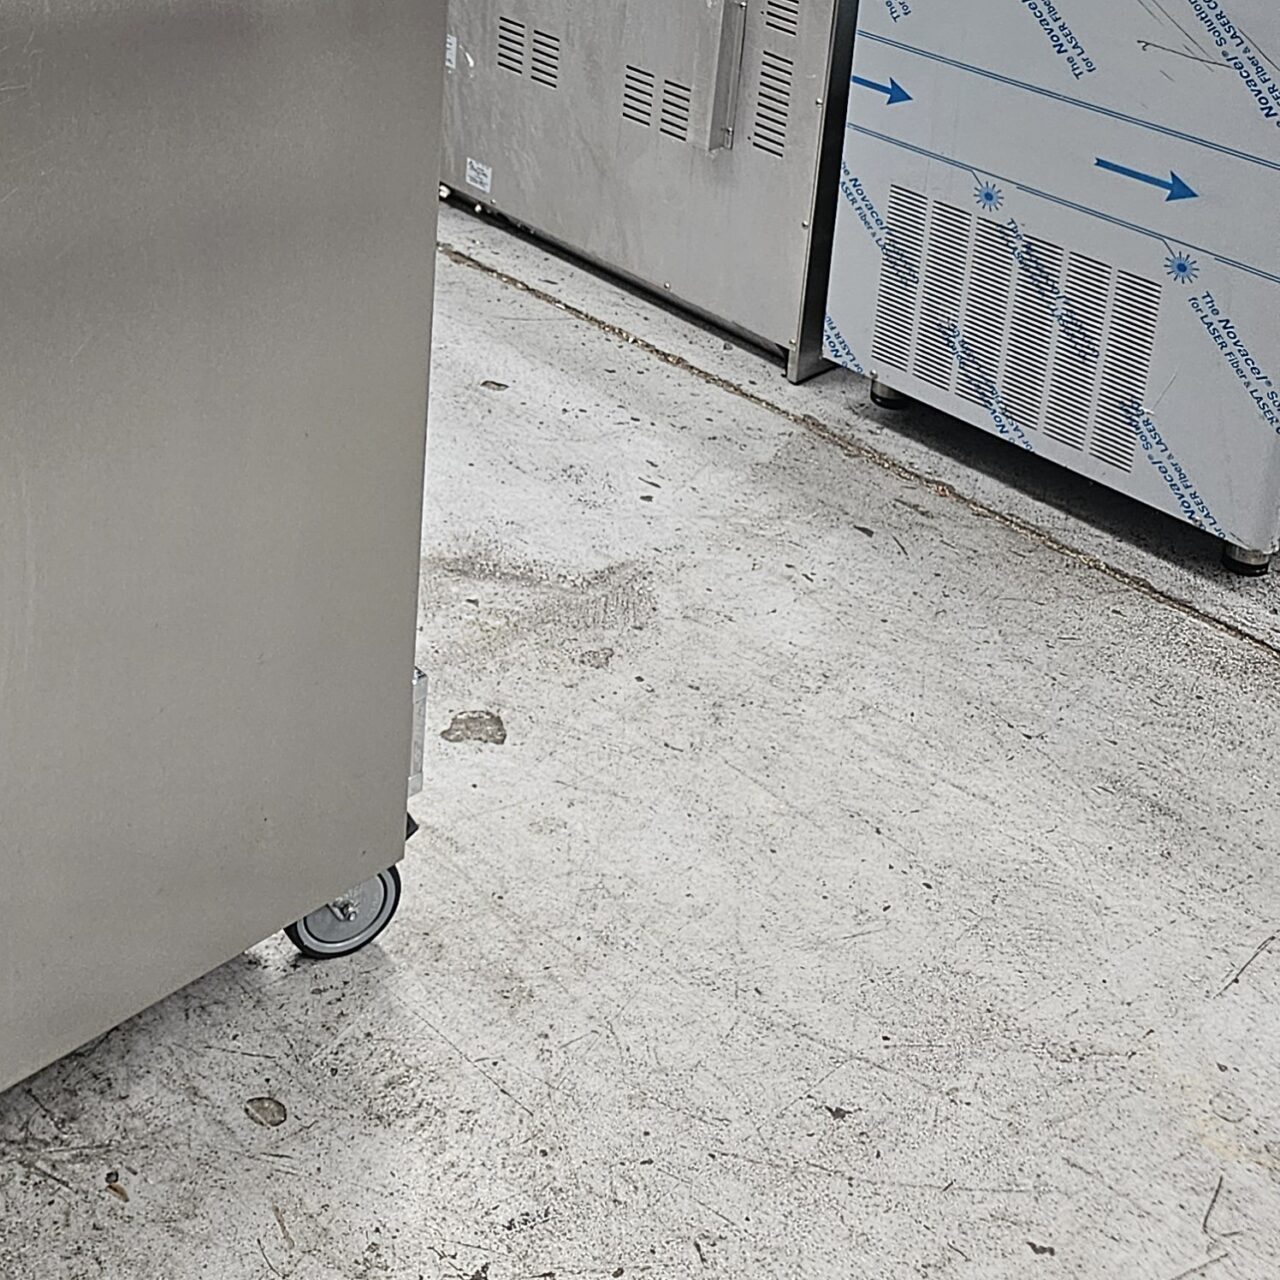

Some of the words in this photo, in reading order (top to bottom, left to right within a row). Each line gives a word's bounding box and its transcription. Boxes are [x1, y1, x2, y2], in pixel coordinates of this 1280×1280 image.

[885, 0, 900, 22] The
[898, 1, 911, 15] for
[1058, 21, 1084, 56] LASER
[1214, 10, 1244, 47] LASER
[1066, 56, 1083, 80] The
[1081, 57, 1096, 72] for
[1246, 55, 1271, 84] Fiber
[837, 180, 857, 205] ASER
[1201, 290, 1219, 315] The
[1187, 296, 1203, 313] for
[1199, 314, 1227, 350] LASER
[1223, 351, 1247, 379] Fiber
[1249, 388, 1279, 425] LASER
[1141, 416, 1168, 452] LASER
[1188, 490, 1217, 526] LASER
